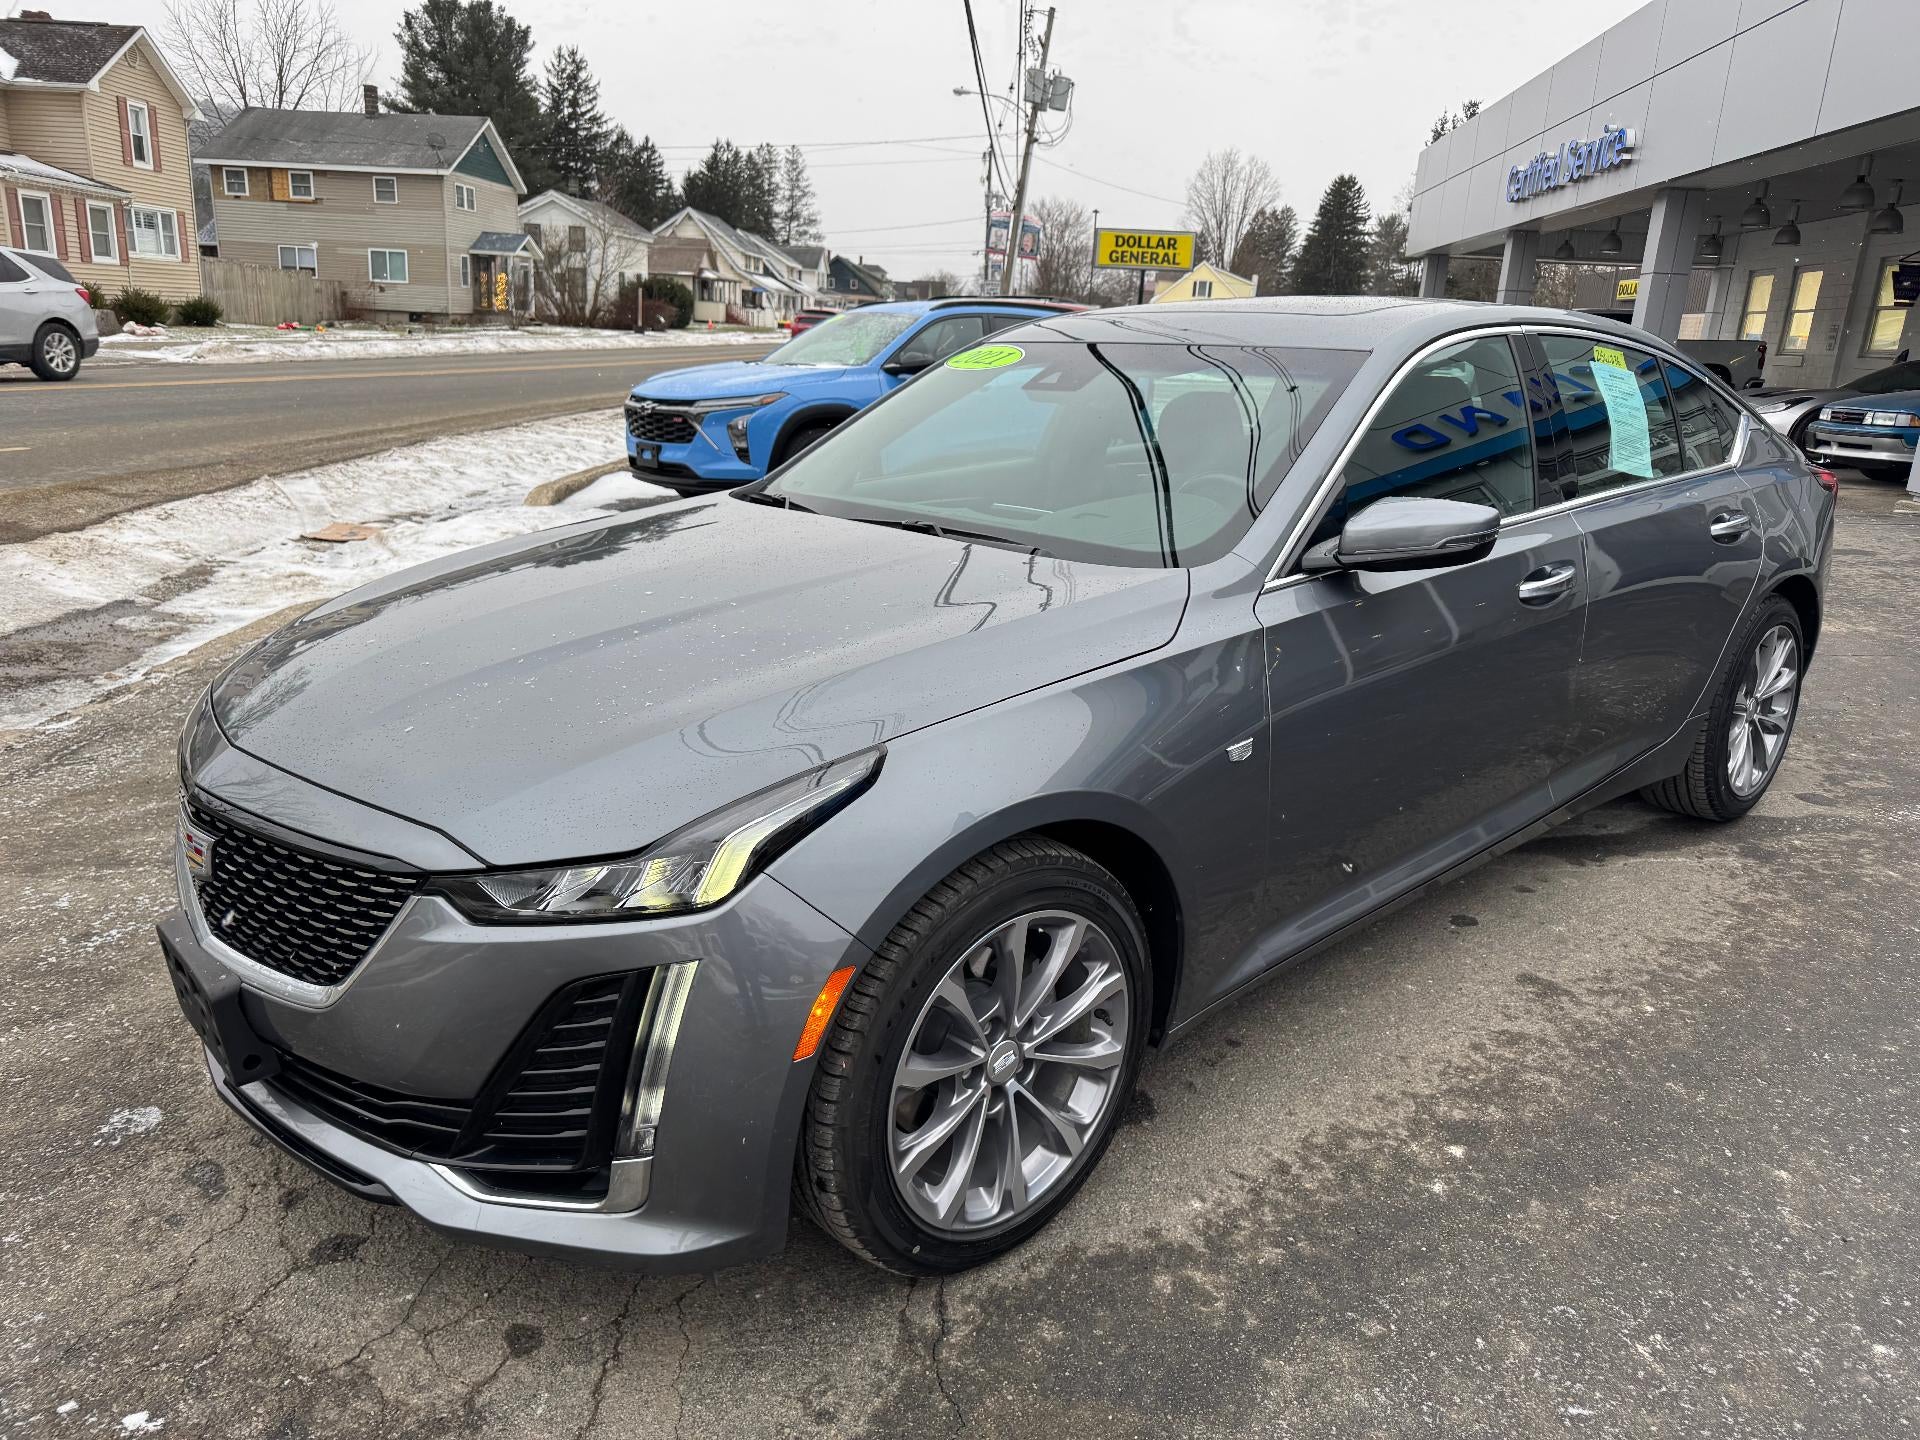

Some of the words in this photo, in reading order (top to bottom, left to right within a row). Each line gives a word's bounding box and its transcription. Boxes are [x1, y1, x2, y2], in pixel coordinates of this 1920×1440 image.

[1506, 142, 1565, 202] Certified
[1563, 125, 1629, 183] Service
[1115, 235, 1178, 250] DOLLAR
[1109, 250, 1181, 265] GENERAL
[1619, 283, 1638, 296] DOLLA
